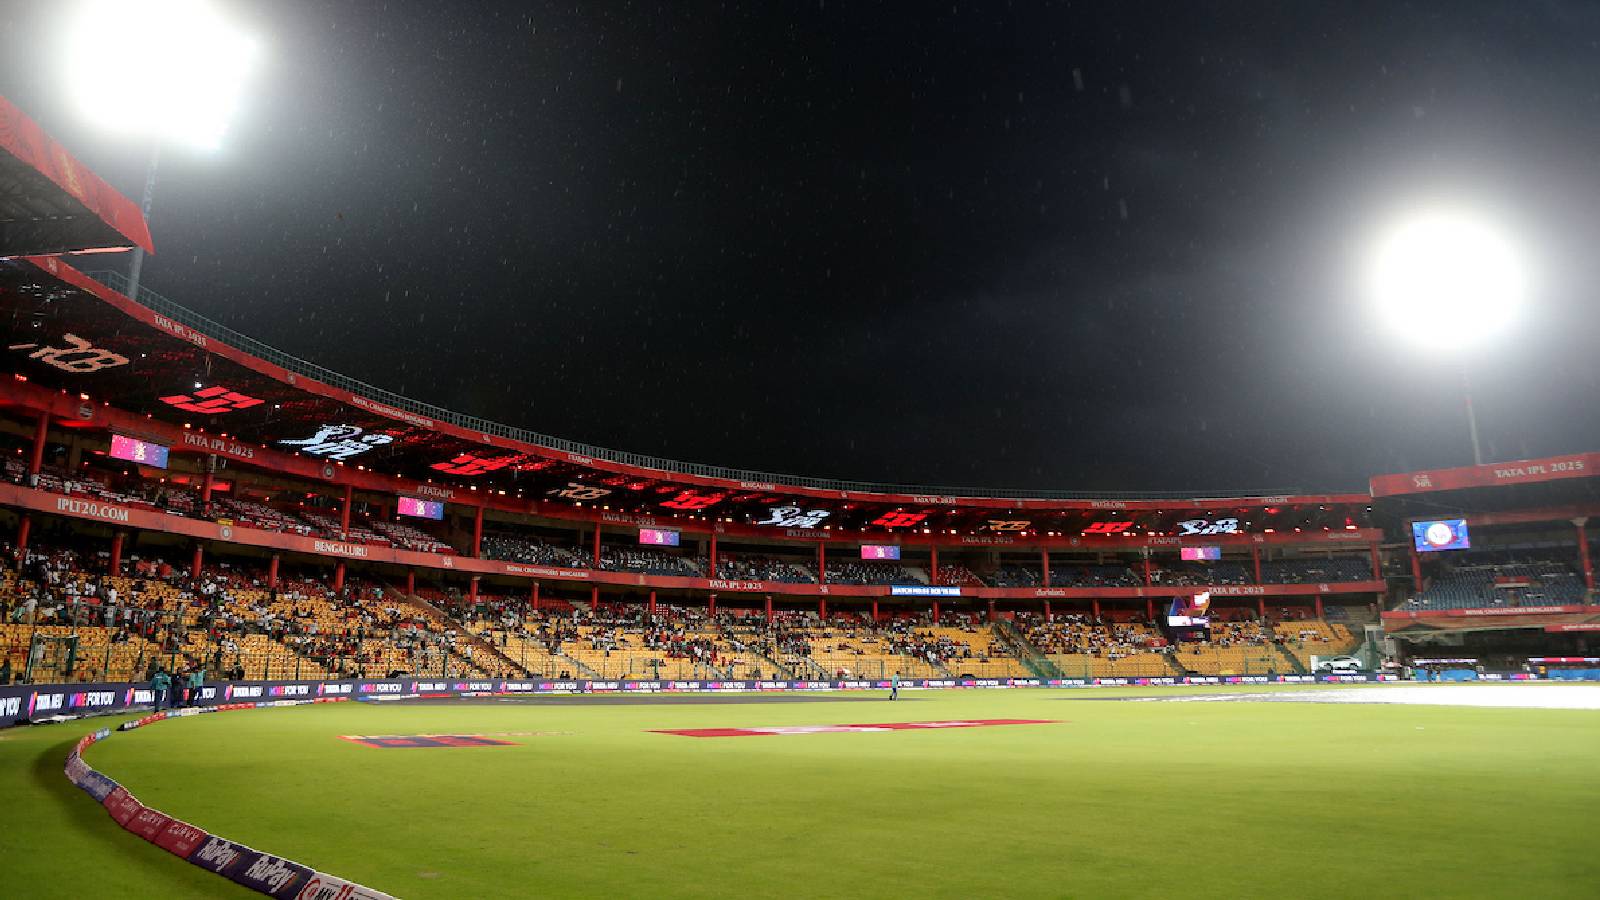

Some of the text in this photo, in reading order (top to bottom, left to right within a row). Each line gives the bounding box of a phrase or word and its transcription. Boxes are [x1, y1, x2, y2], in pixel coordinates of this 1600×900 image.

[183, 432, 254, 459] TATA IPL 2025
[1494, 461, 1585, 479] TATA IPL 2025
[57, 498, 129, 522] IPLT20.COM
[314, 540, 368, 557] BENGALURU
[709, 580, 762, 590] TATA IPL 2025
[296, 685, 308, 695] YOU
[390, 684, 402, 692] YOU
[100, 692, 116, 706] YOU
[245, 854, 297, 894] RuPay
